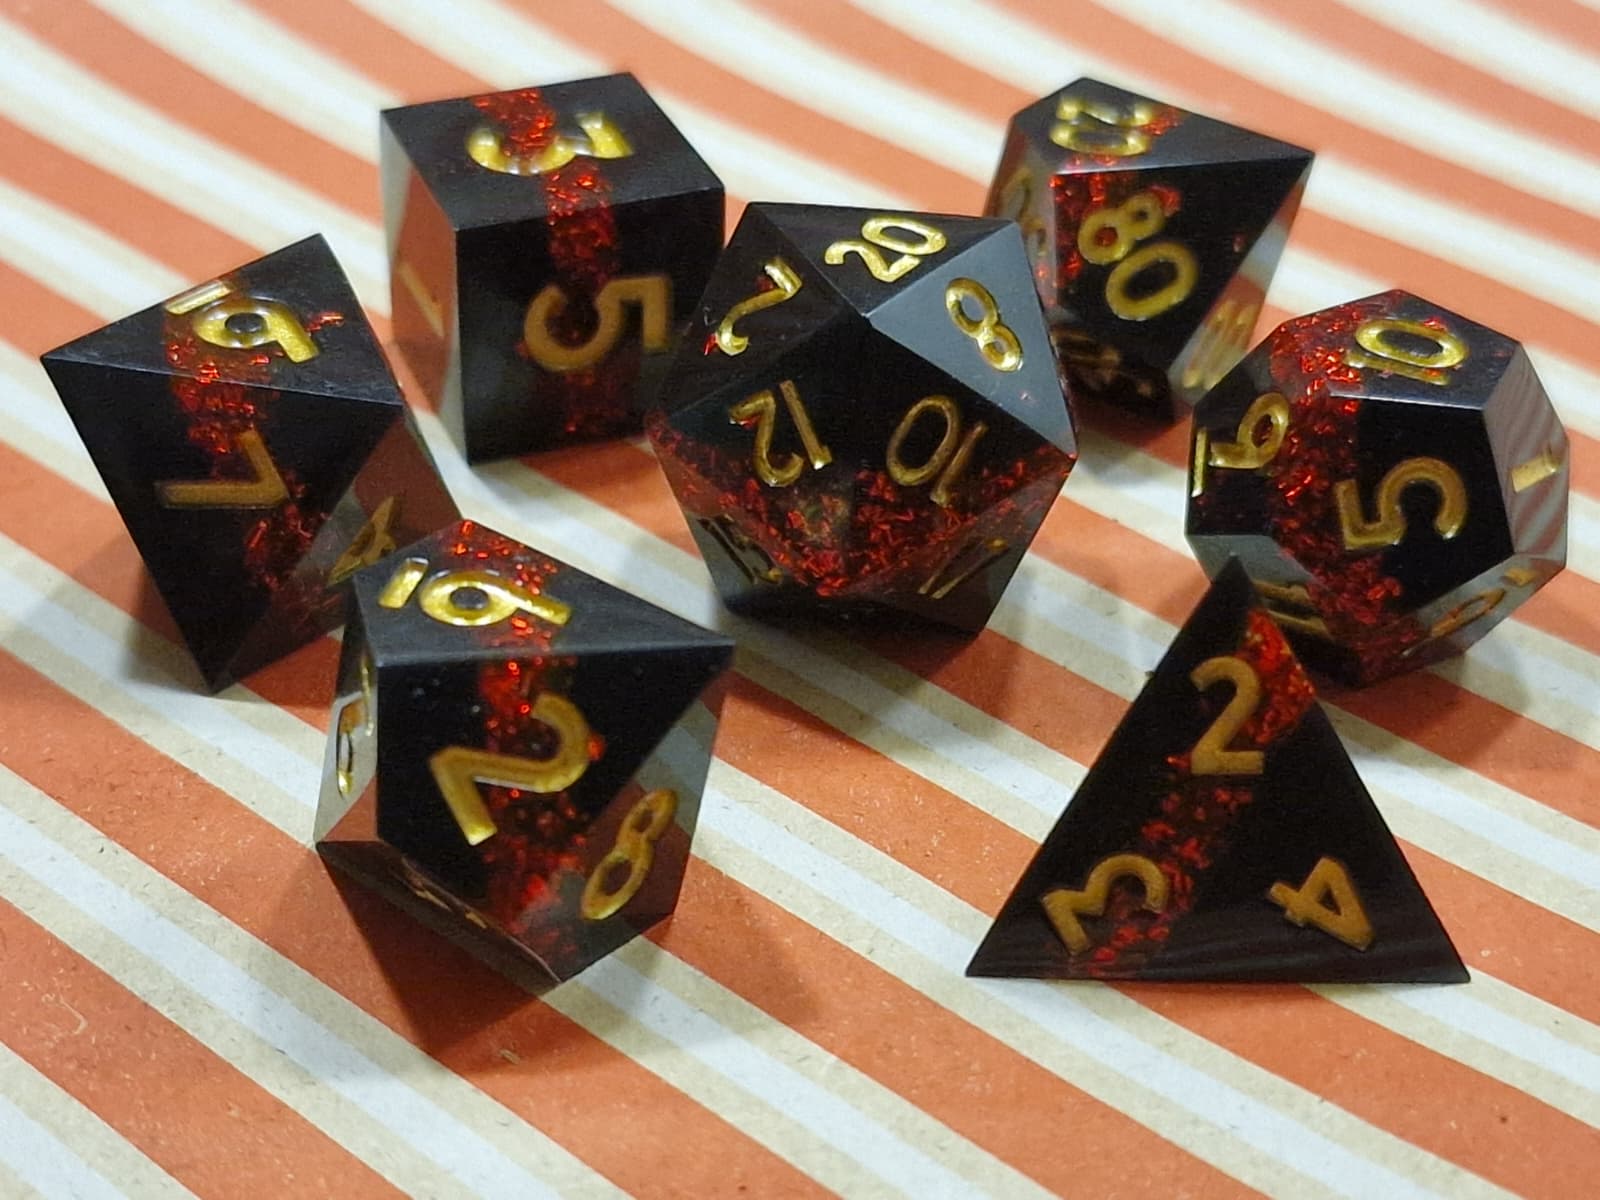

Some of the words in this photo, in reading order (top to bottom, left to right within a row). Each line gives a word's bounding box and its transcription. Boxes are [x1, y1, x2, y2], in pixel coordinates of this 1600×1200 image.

[467, 112, 634, 176] 3
[824, 217, 947, 283] 20
[1077, 192, 1198, 321] 80
[524, 276, 671, 373] 5
[946, 277, 1024, 372] 8
[1345, 319, 1469, 386] 10
[154, 428, 289, 509] 7
[730, 380, 832, 487] 12
[887, 396, 987, 497] 10
[1335, 456, 1467, 550] 5
[1190, 656, 1264, 775] 2
[430, 693, 590, 847] 2
[581, 789, 678, 920] 8
[1042, 854, 1169, 956] 3
[1270, 856, 1375, 951] 4
